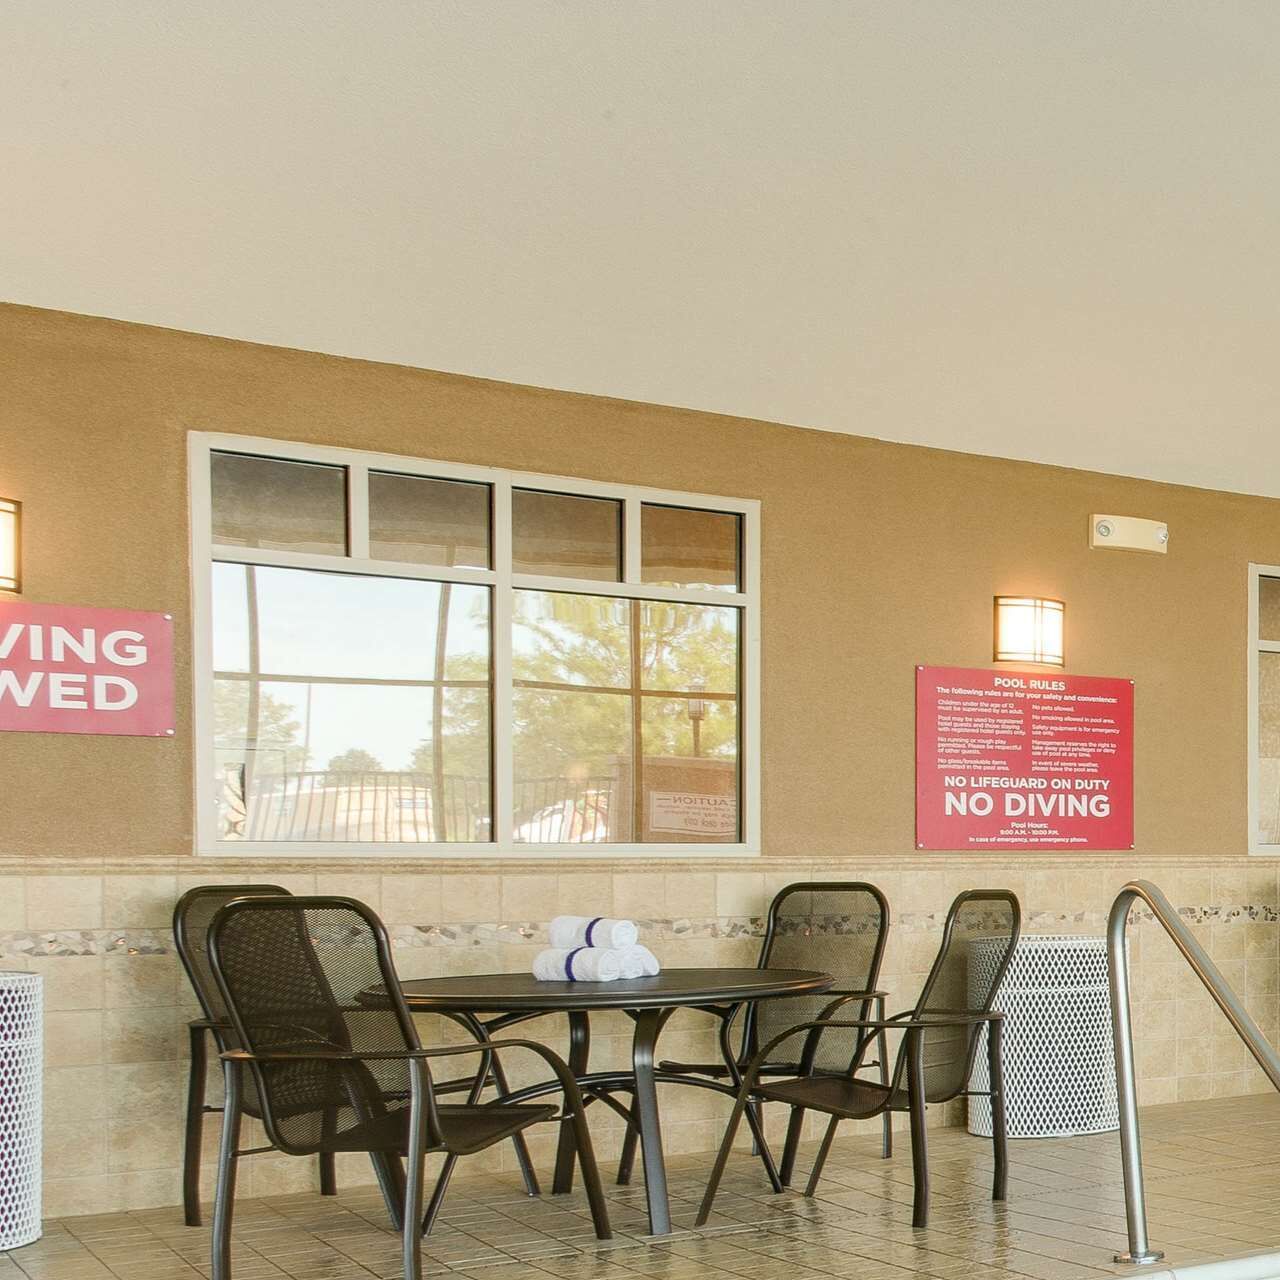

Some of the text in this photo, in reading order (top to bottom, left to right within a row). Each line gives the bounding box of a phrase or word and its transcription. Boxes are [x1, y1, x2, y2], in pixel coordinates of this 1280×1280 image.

[994, 677, 1066, 691] POOL RULES
[952, 688, 983, 696] following
[1027, 692, 1041, 700] your
[1043, 693, 1062, 701] safety
[1064, 694, 1076, 702] and
[945, 775, 1110, 791] NO LIFEGUARD ON DUTY
[945, 791, 1110, 818] NO DIVING
